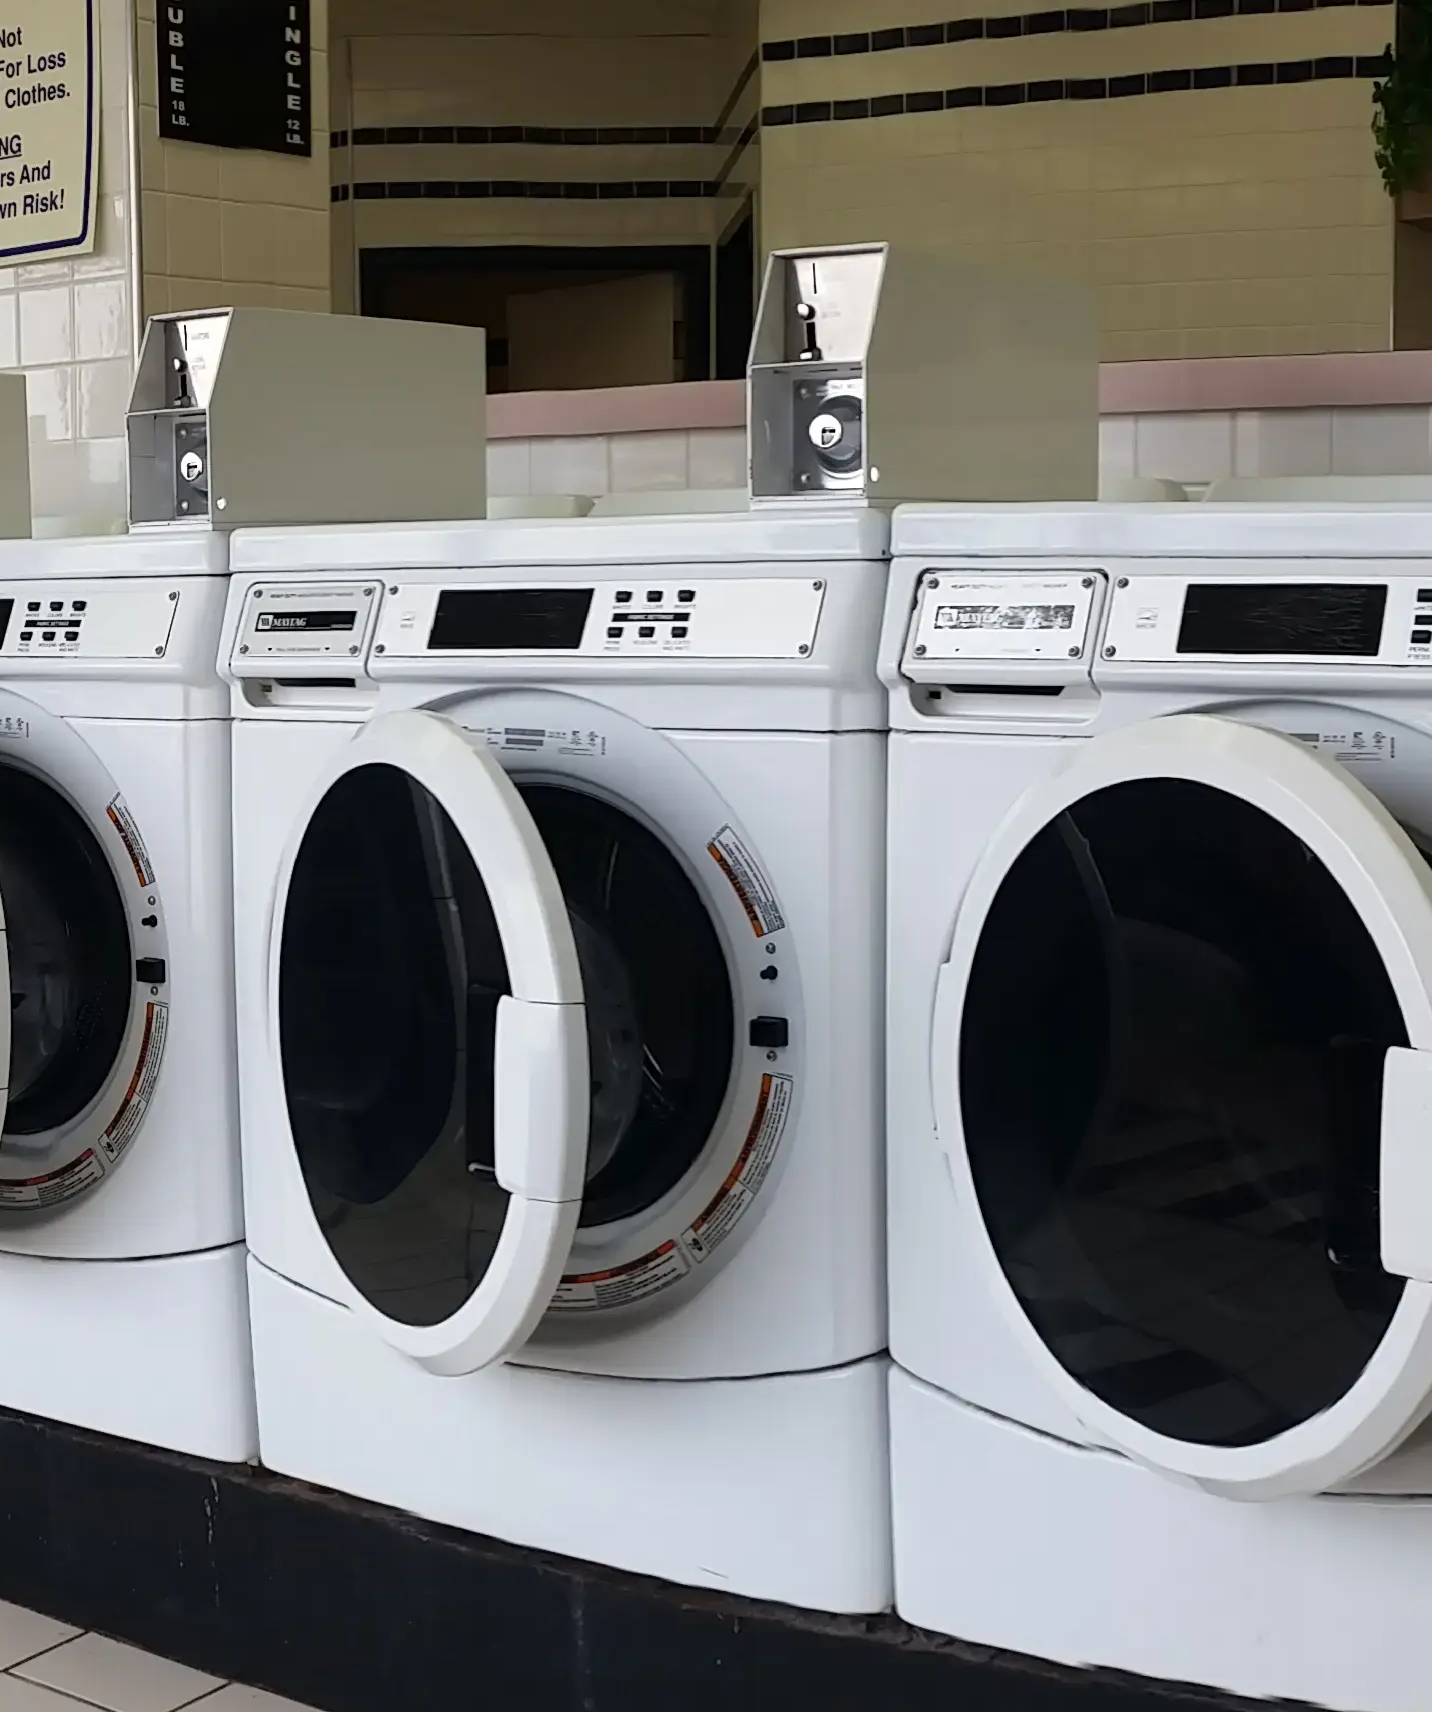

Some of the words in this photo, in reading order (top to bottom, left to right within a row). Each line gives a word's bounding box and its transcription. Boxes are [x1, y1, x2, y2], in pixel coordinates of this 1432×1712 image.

[168, 5, 184, 93] UBLE
[27, 52, 66, 74] Loss
[5, 82, 70, 109] Clothes.
[172, 100, 185, 111] 18
[172, 114, 190, 126] LB.
[286, 119, 300, 130] 12
[286, 133, 305, 144] LB.
[19, 160, 51, 184] And
[23, 189, 65, 215] Risk!
[271, 617, 307, 627] MAYTAG
